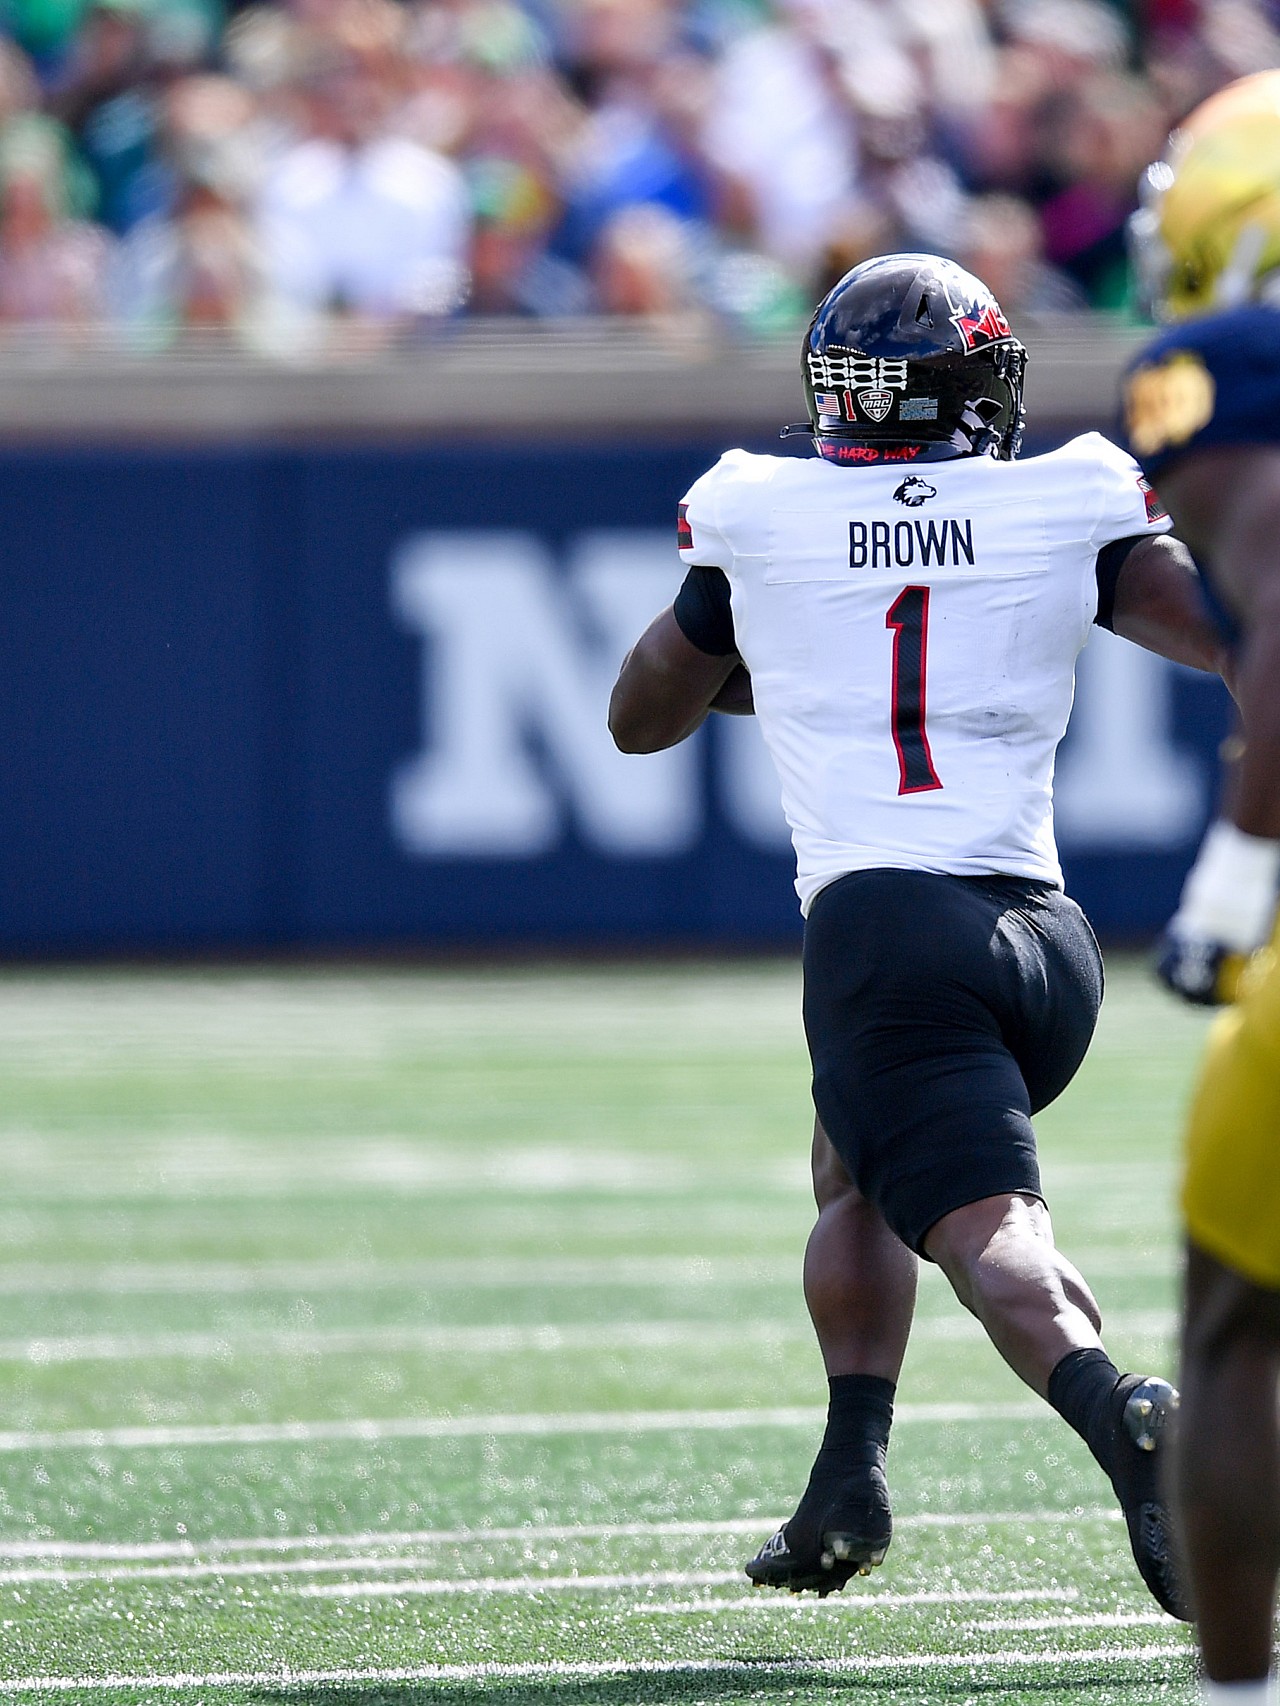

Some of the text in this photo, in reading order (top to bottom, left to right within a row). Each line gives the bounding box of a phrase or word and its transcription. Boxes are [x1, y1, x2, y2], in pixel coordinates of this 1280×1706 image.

[843, 390, 857, 421] 1
[863, 399, 891, 408] MAC
[838, 446, 879, 461] HARD
[884, 446, 921, 460] WAY
[849, 519, 975, 568] BROWN
[886, 585, 944, 796] 1
